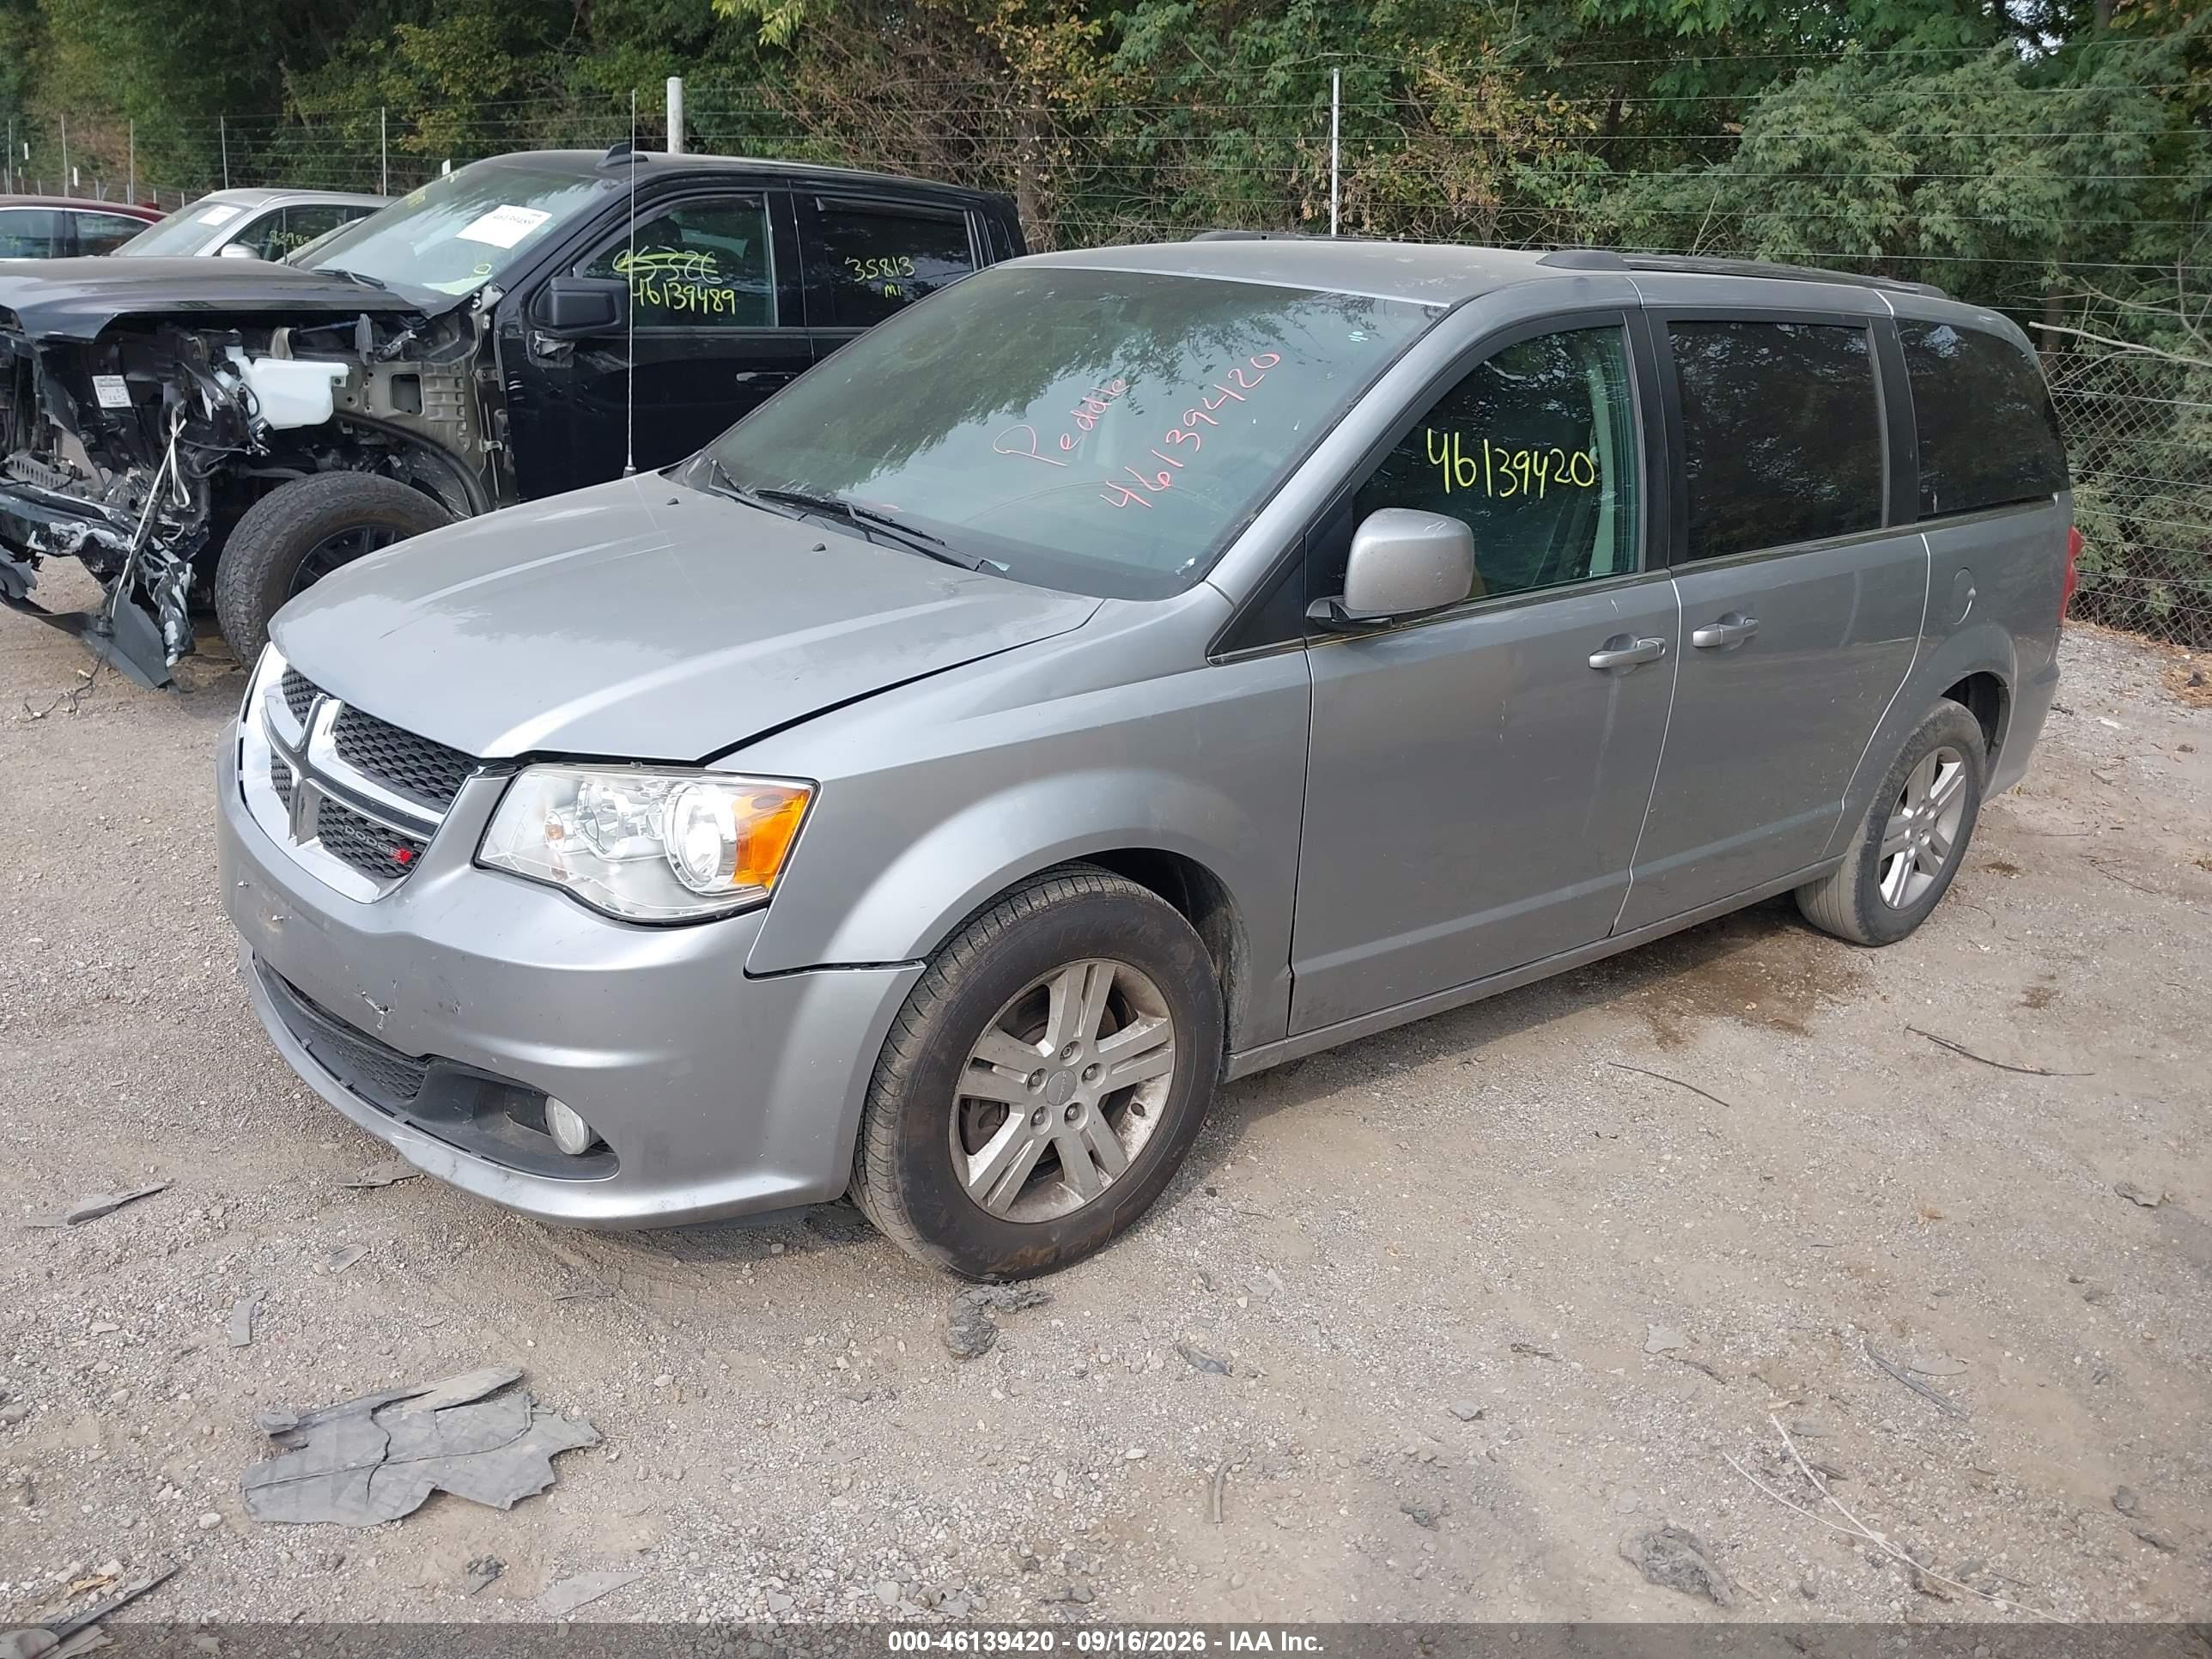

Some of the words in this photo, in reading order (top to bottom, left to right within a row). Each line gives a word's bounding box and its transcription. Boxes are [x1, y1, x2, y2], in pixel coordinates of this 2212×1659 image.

[632, 277, 736, 315] 46139489
[844, 257, 915, 282] 35813
[993, 378, 1130, 467] Peddle
[1099, 352, 1280, 509] 46139420
[1427, 428, 1595, 499] 46139420
[344, 824, 401, 860] DODGE
